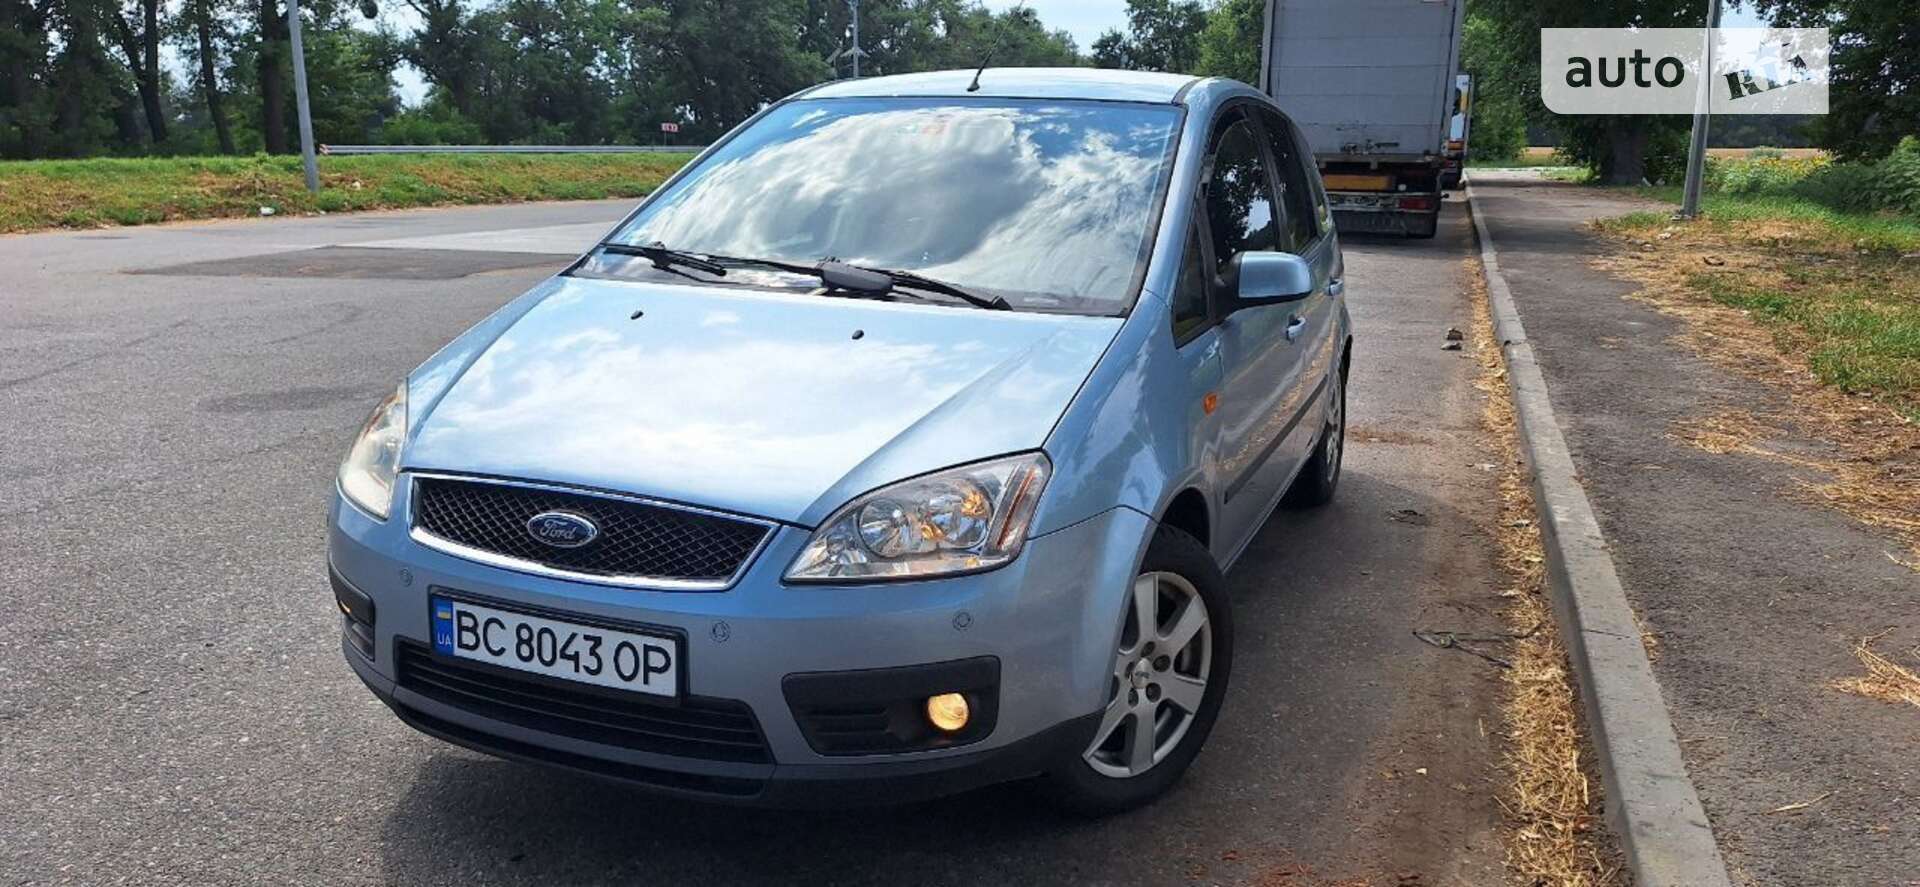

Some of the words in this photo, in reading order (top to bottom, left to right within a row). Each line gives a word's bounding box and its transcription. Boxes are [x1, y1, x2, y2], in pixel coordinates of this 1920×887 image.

[540, 518, 578, 540] Ford
[437, 633, 453, 648] UA
[456, 610, 506, 657] BC
[515, 622, 603, 676] 8043
[613, 640, 672, 685] OP
